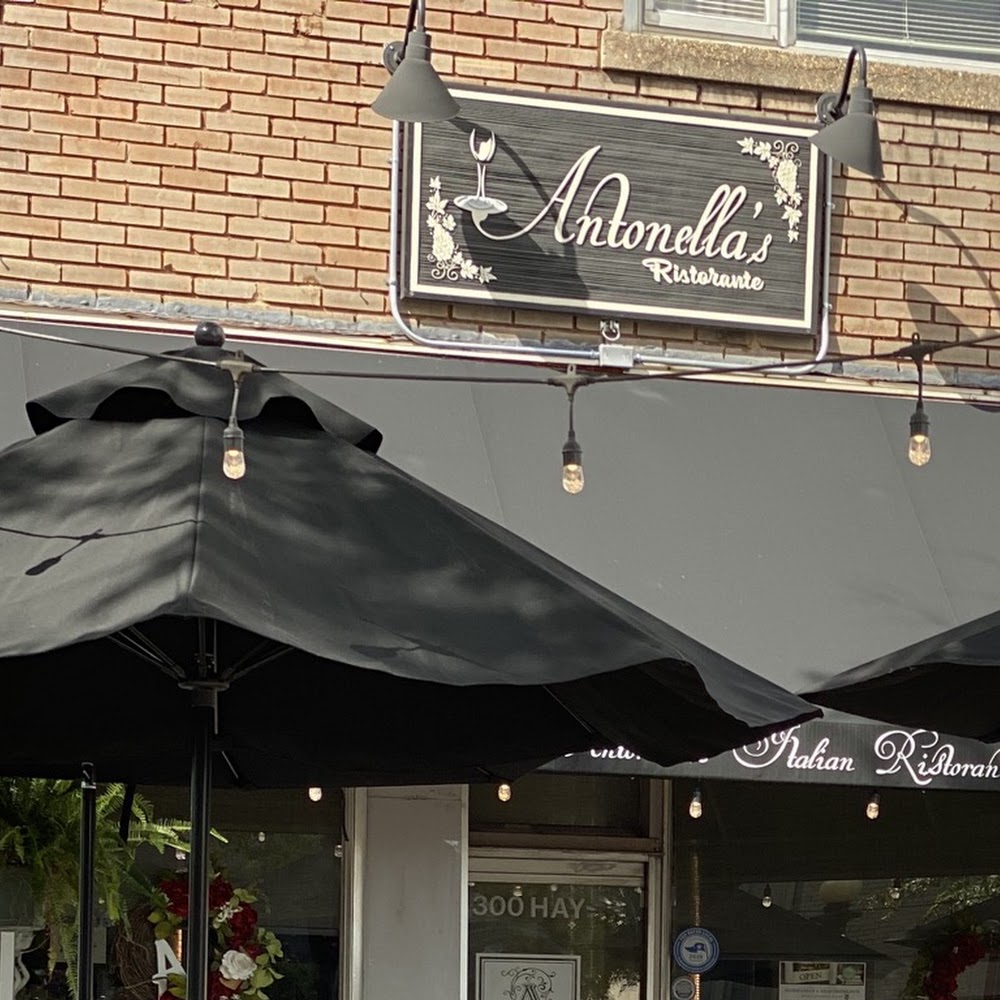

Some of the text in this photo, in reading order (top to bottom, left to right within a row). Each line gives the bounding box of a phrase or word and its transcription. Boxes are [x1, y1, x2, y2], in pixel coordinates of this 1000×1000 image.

[482, 145, 773, 264] Antonella's
[642, 258, 765, 291] Ristorante
[733, 725, 855, 772] Italian
[472, 895, 585, 919] 300 HAY
